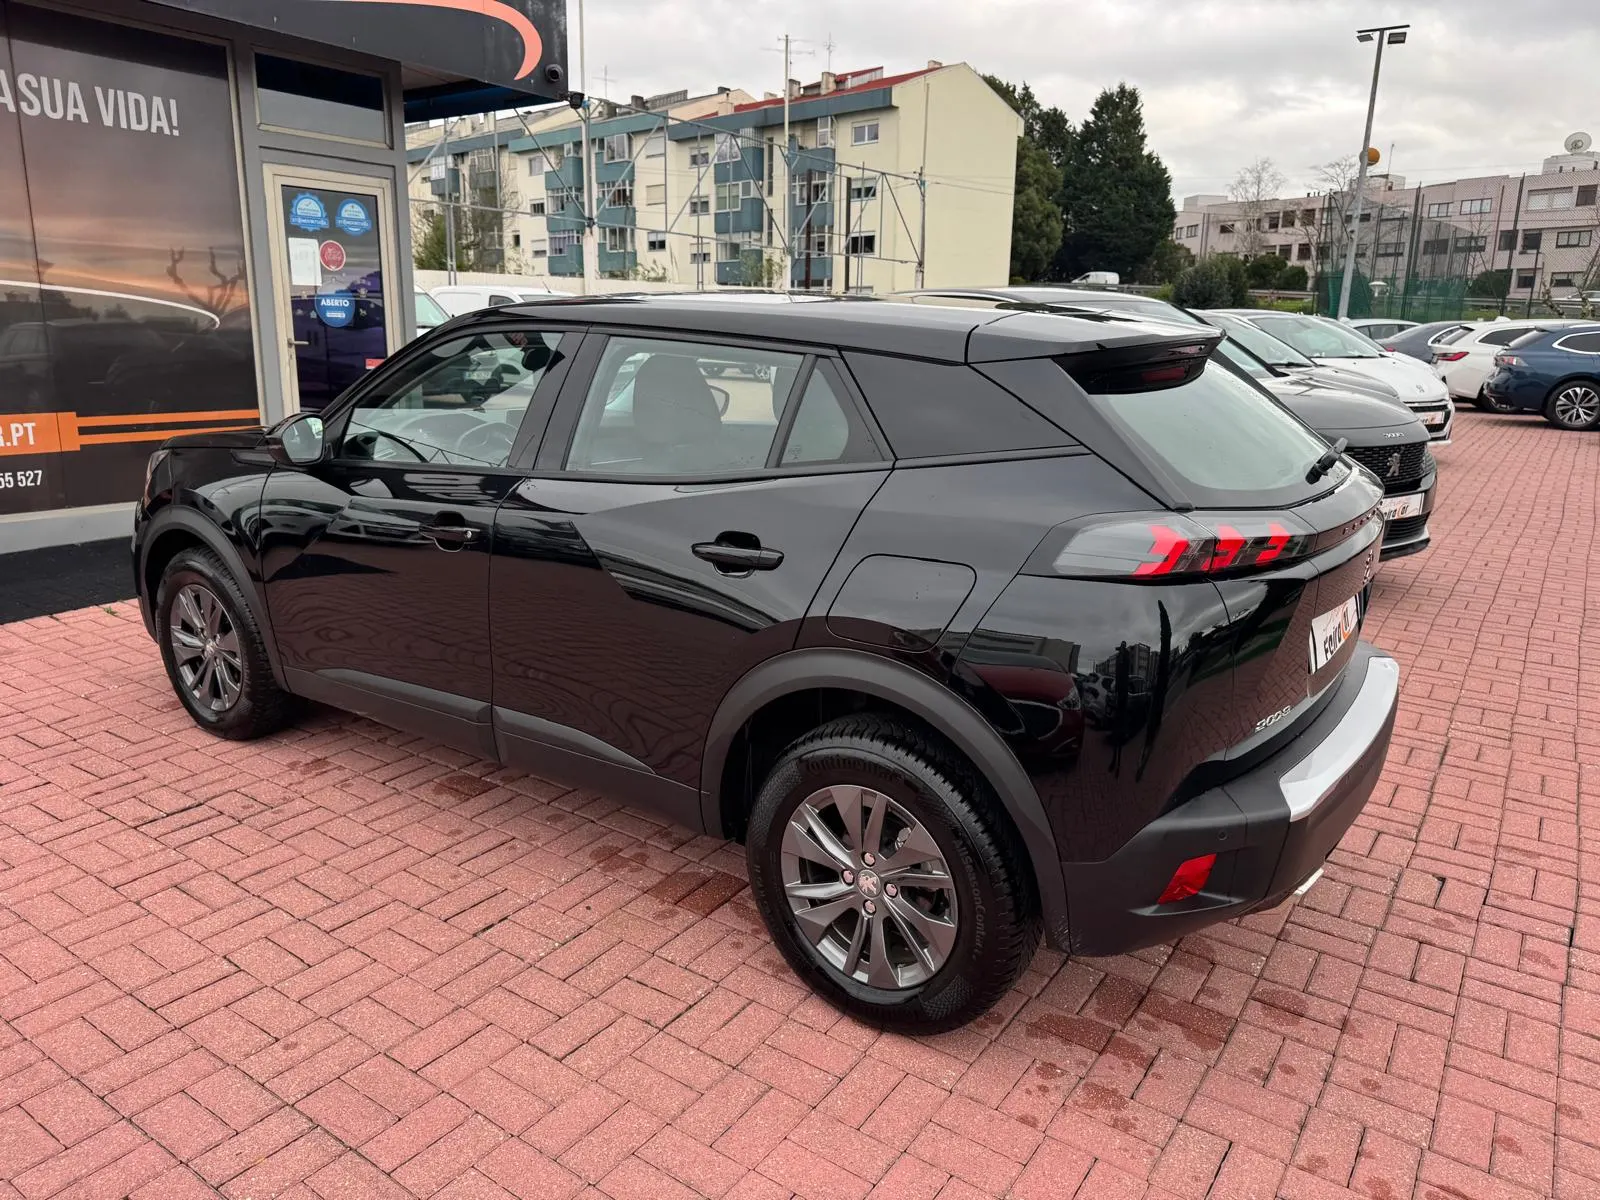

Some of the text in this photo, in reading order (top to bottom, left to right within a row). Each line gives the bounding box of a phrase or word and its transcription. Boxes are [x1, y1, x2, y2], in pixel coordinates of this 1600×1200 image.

[94, 86, 180, 136] VIDA!
[320, 298, 350, 307] ABERTO
[17, 470, 43, 487] 527
[1255, 705, 1291, 732] 2008
